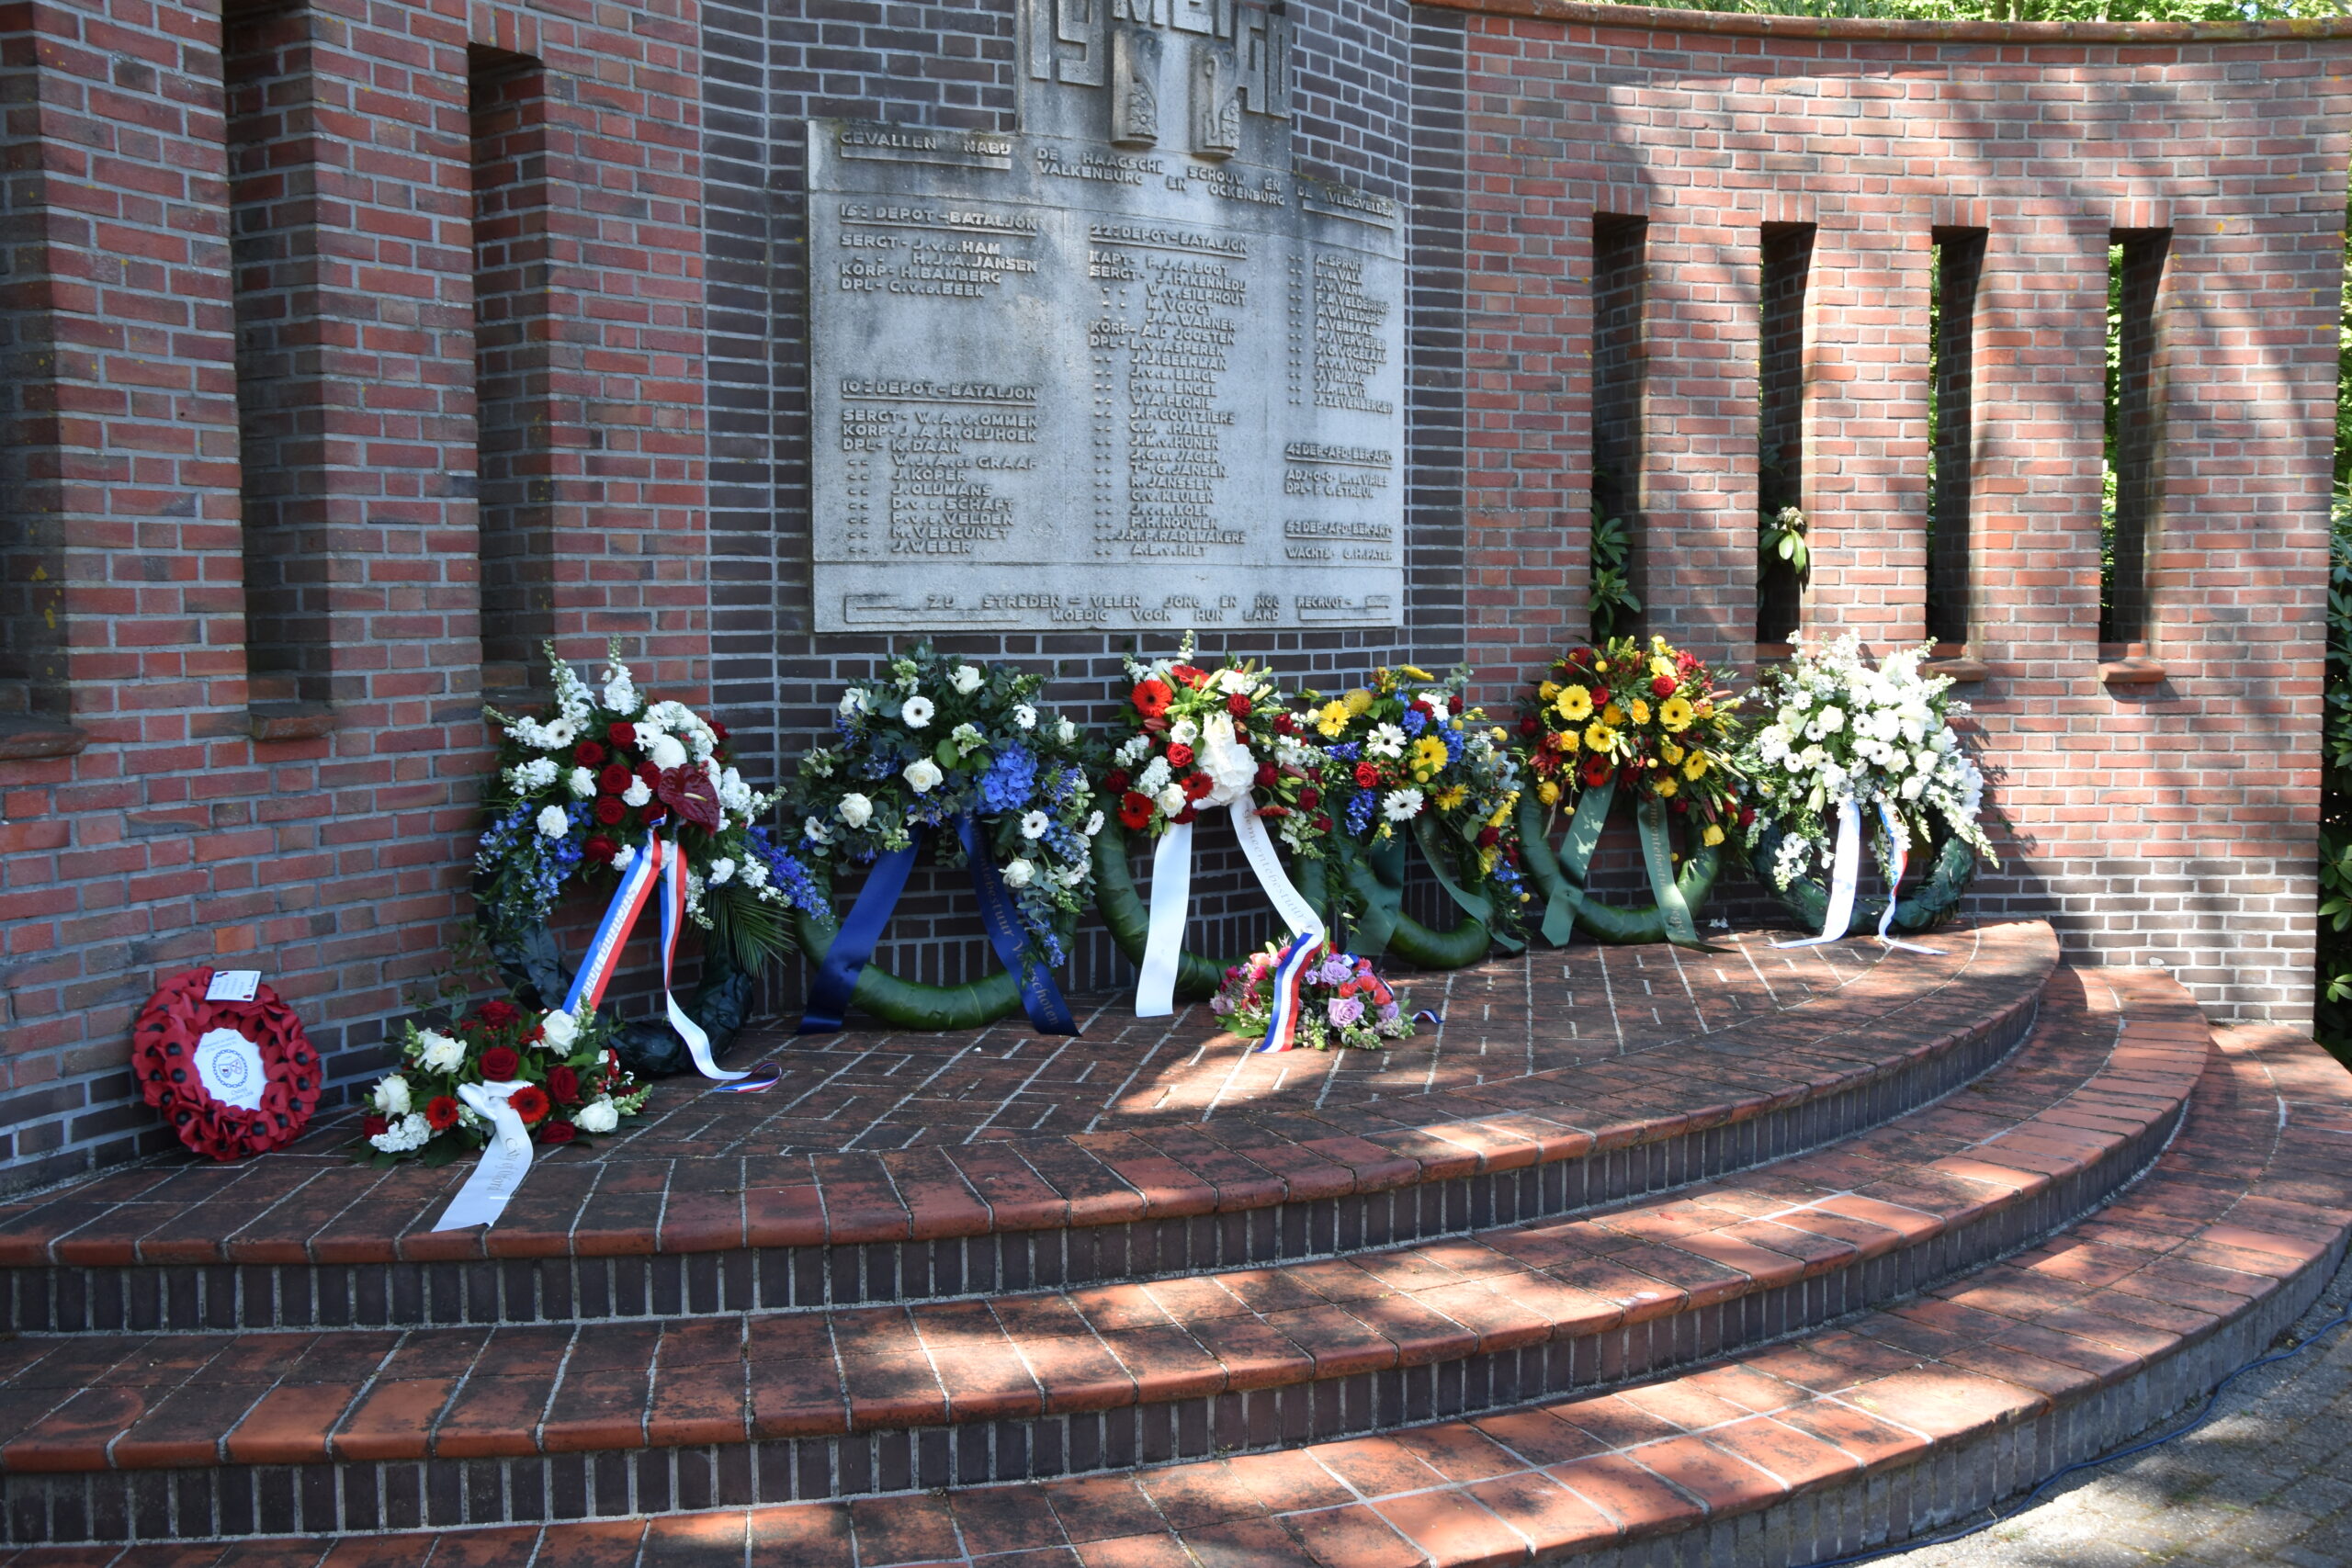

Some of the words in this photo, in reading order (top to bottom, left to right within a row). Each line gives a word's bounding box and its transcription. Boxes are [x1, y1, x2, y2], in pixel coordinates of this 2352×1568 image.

[840, 131, 937, 150] GEVALLEN
[1036, 147, 1058, 160] DE
[1083, 152, 1165, 175] HAAGSCHE
[1188, 166, 1246, 186] SCHOUW
[1264, 177, 1281, 192] EN
[1297, 186, 1312, 198] DE
[1328, 191, 1395, 218] VLIEGVELDEN
[1037, 162, 1142, 185] VALKENBURG
[1166, 176, 1187, 191] EN
[1209, 185, 1285, 206] OCKENBURG
[983, 596, 1060, 608] STREDEN
[1091, 595, 1139, 608] VELEN
[1163, 597, 1200, 608] JONG
[1221, 596, 1237, 608] EN
[1051, 610, 1109, 622] MOEDIG
[1132, 609, 1170, 621] VOOR
[1194, 610, 1223, 621] HUN
[1244, 609, 1280, 621] LAND
